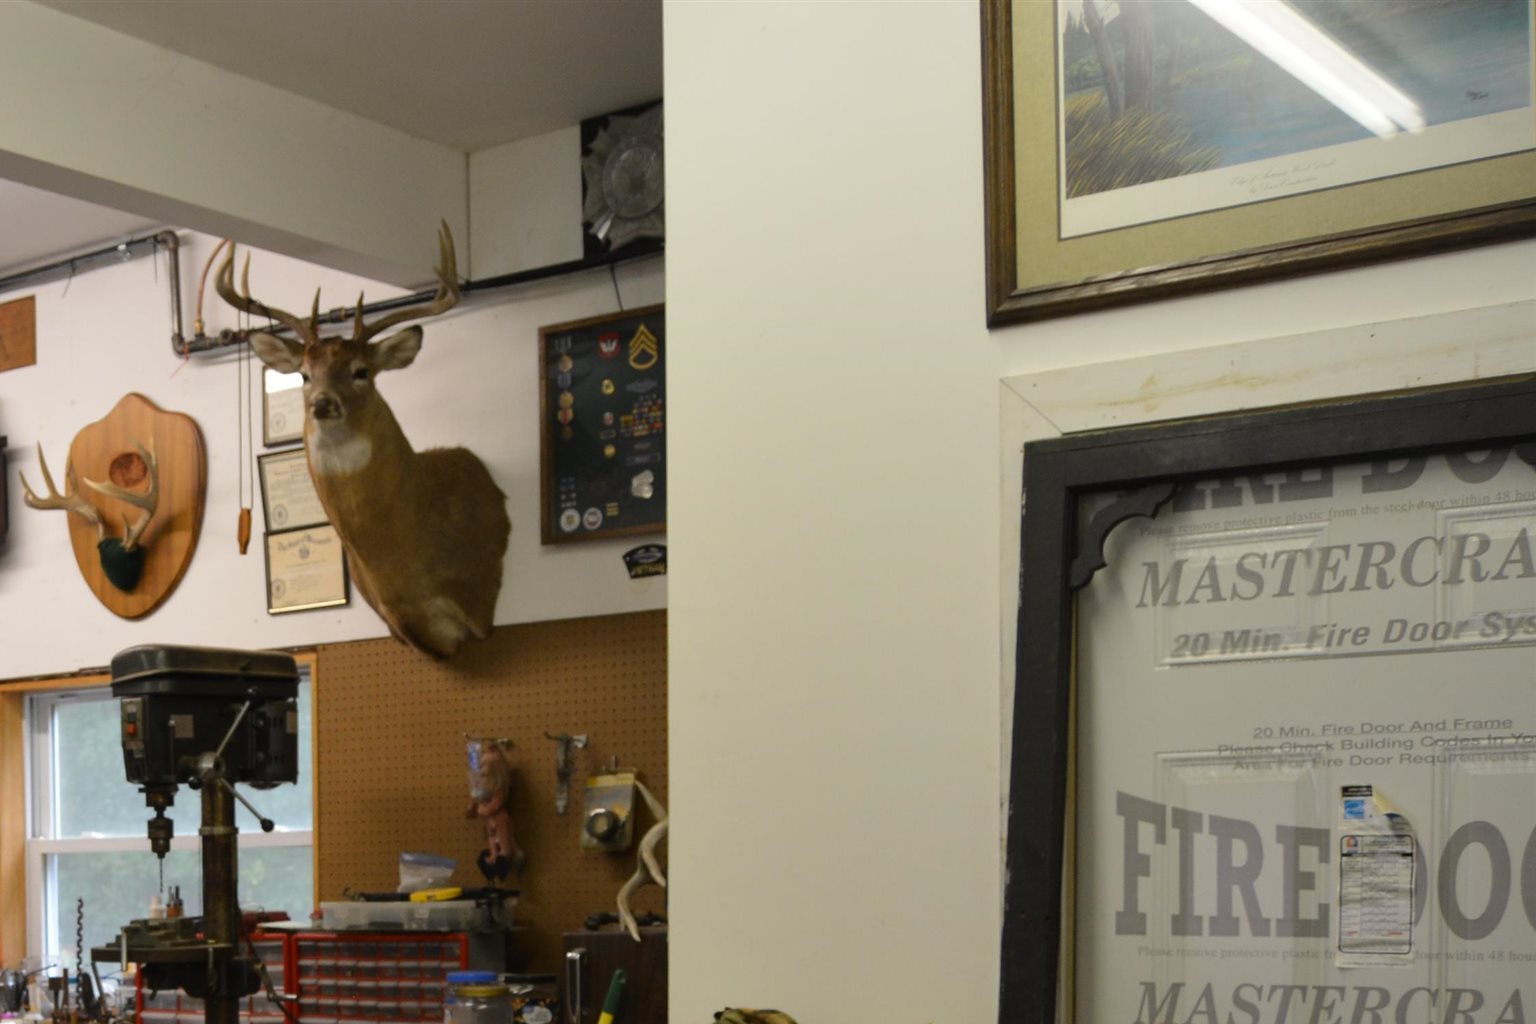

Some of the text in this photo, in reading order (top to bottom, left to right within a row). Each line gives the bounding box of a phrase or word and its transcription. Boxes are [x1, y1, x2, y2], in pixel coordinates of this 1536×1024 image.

[1224, 514, 1281, 531] protective
[1286, 508, 1323, 526] plastic
[1328, 506, 1357, 519] from
[1360, 503, 1379, 516] the
[1495, 491, 1511, 503] 48
[1135, 526, 1536, 609] MASTERCRA
[1170, 632, 1210, 659] 20
[1219, 627, 1289, 657] Min.
[1306, 622, 1369, 650] Fire
[1382, 614, 1464, 645] Door
[1252, 717, 1513, 739] 20 Min. Fire Door And Frame
[1341, 737, 1414, 753] Building
[1420, 735, 1481, 748] Codes
[1487, 733, 1504, 745] In
[1311, 755, 1344, 768] Fire
[1349, 753, 1394, 767] Door
[1115, 790, 1331, 938] FIRE
[1282, 947, 1321, 961] plastic
[1446, 950, 1485, 962] within
[1488, 951, 1504, 962] 48
